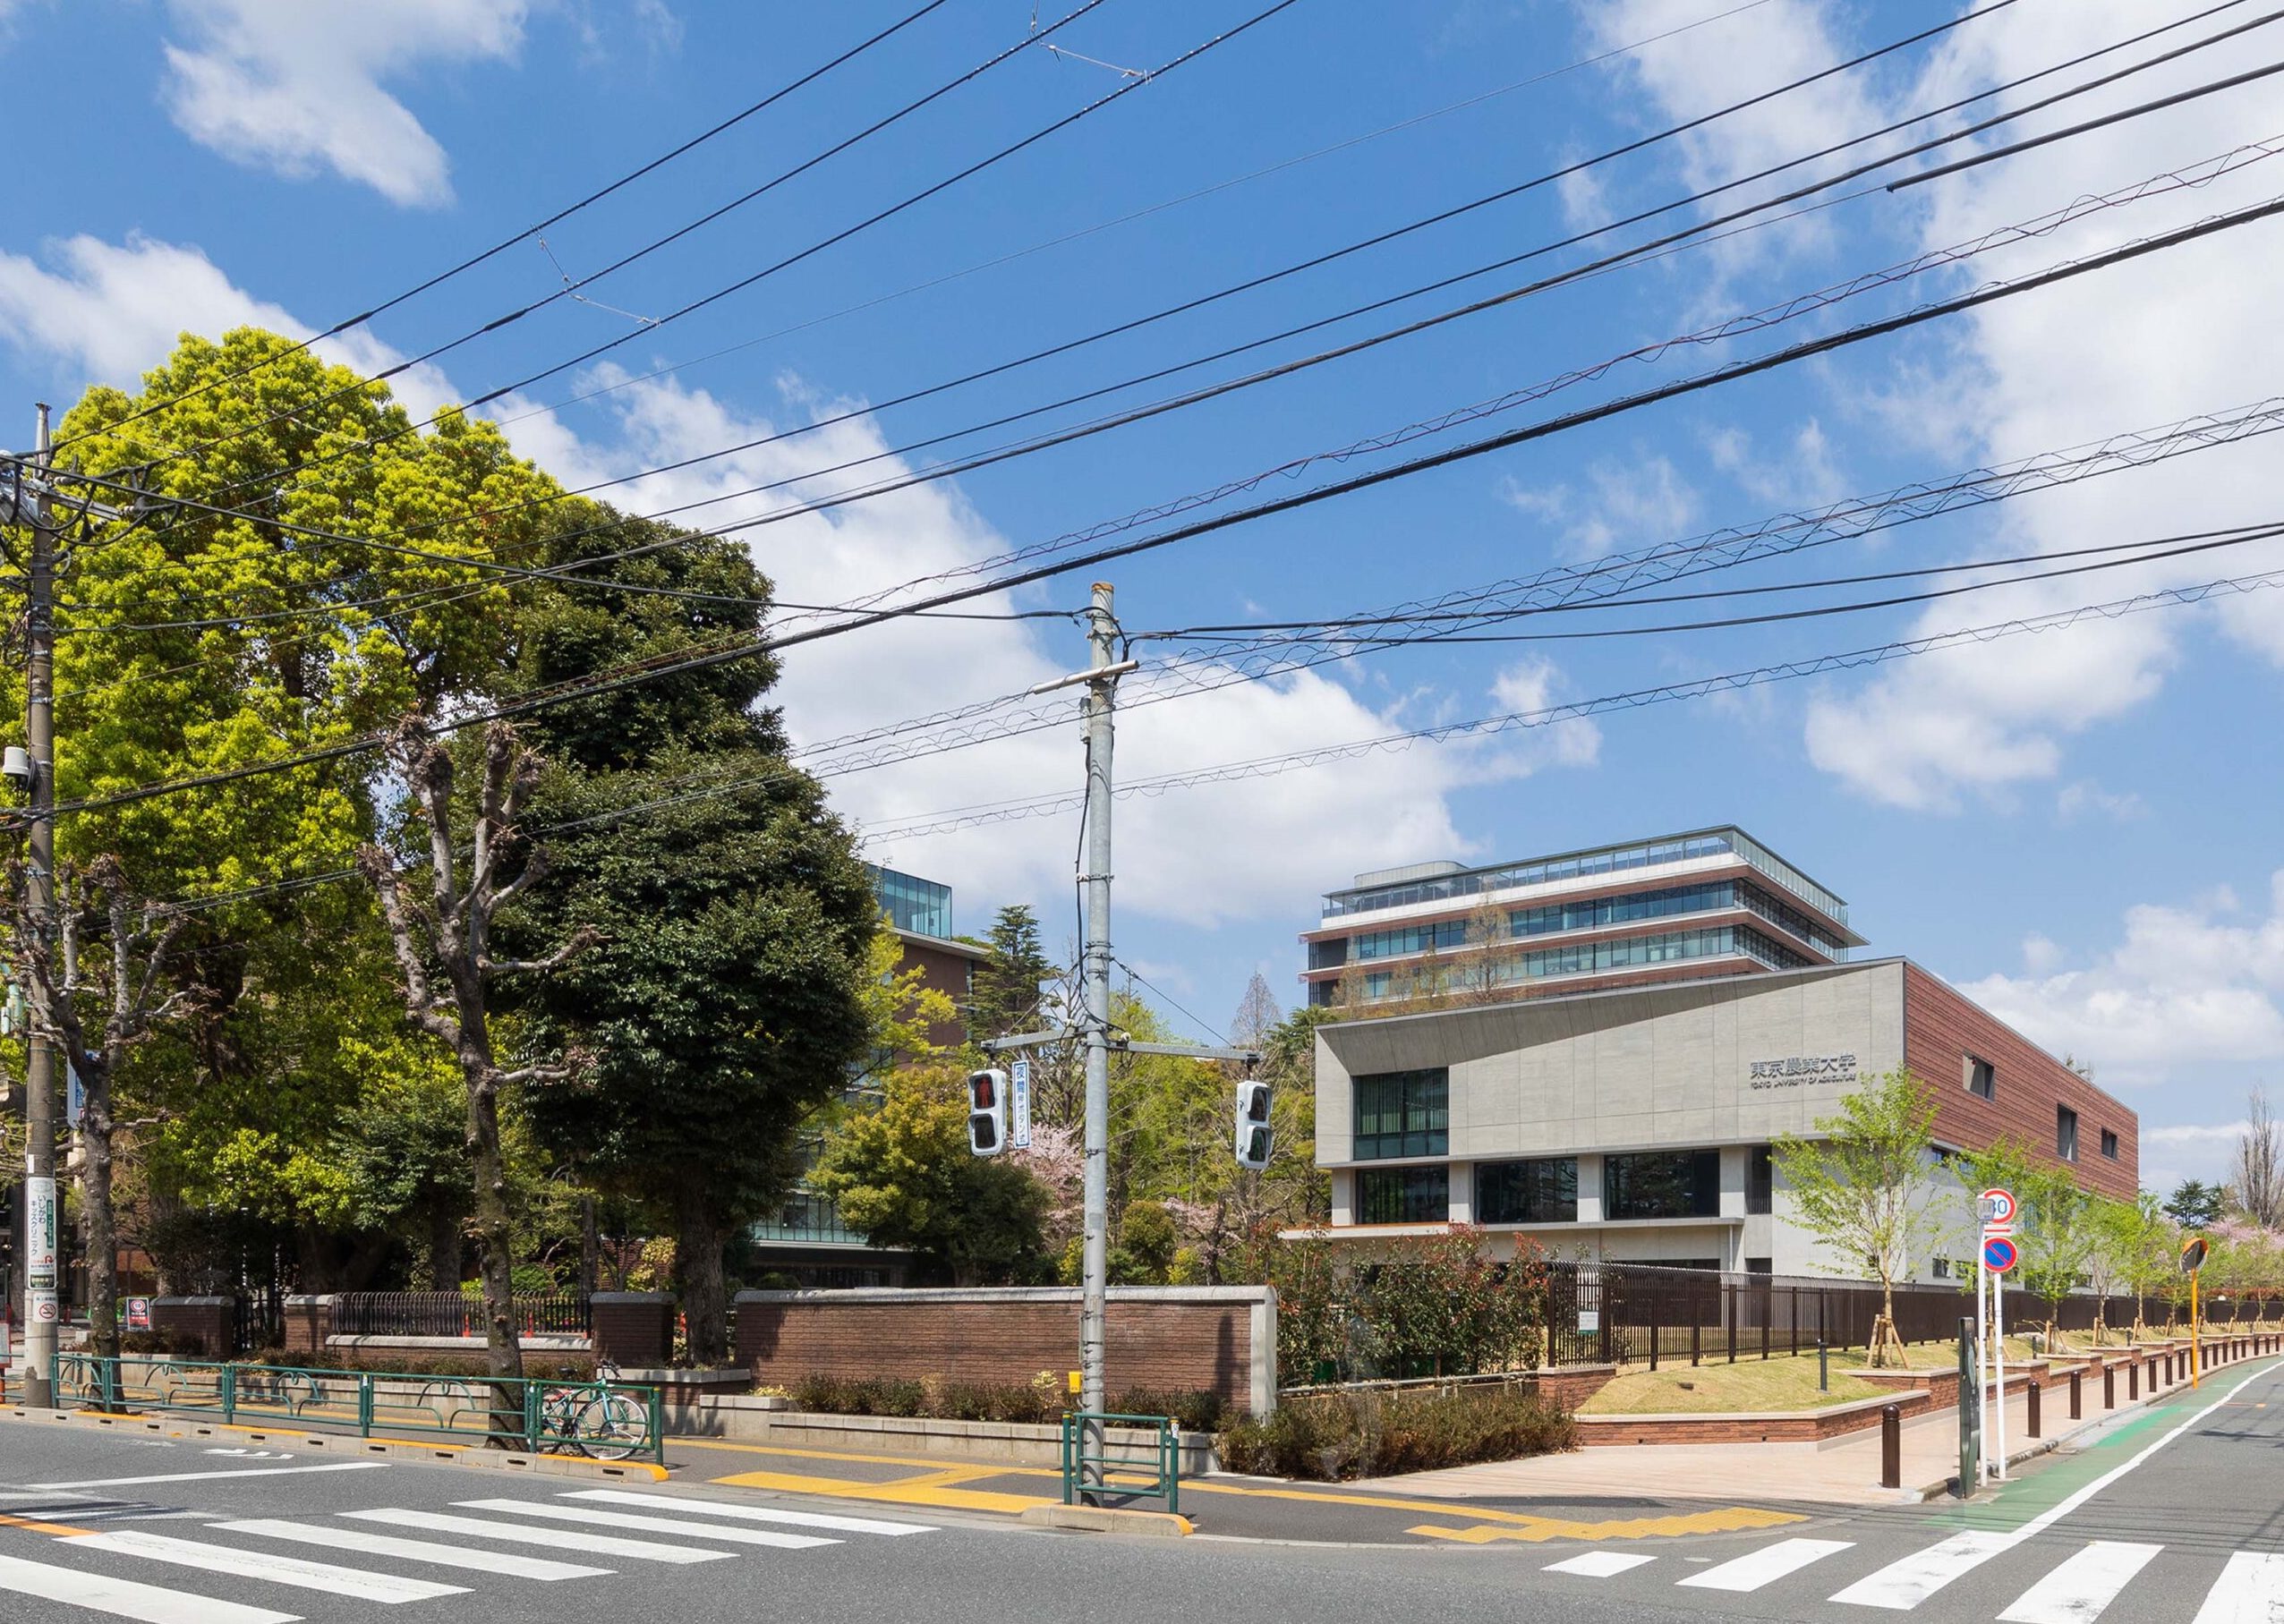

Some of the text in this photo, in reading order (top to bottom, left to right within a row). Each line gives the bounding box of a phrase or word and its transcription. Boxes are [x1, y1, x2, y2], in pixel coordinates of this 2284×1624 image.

[1751, 1053, 1856, 1079] 東京農業大学
[38, 1195, 47, 1224] いしかわ
